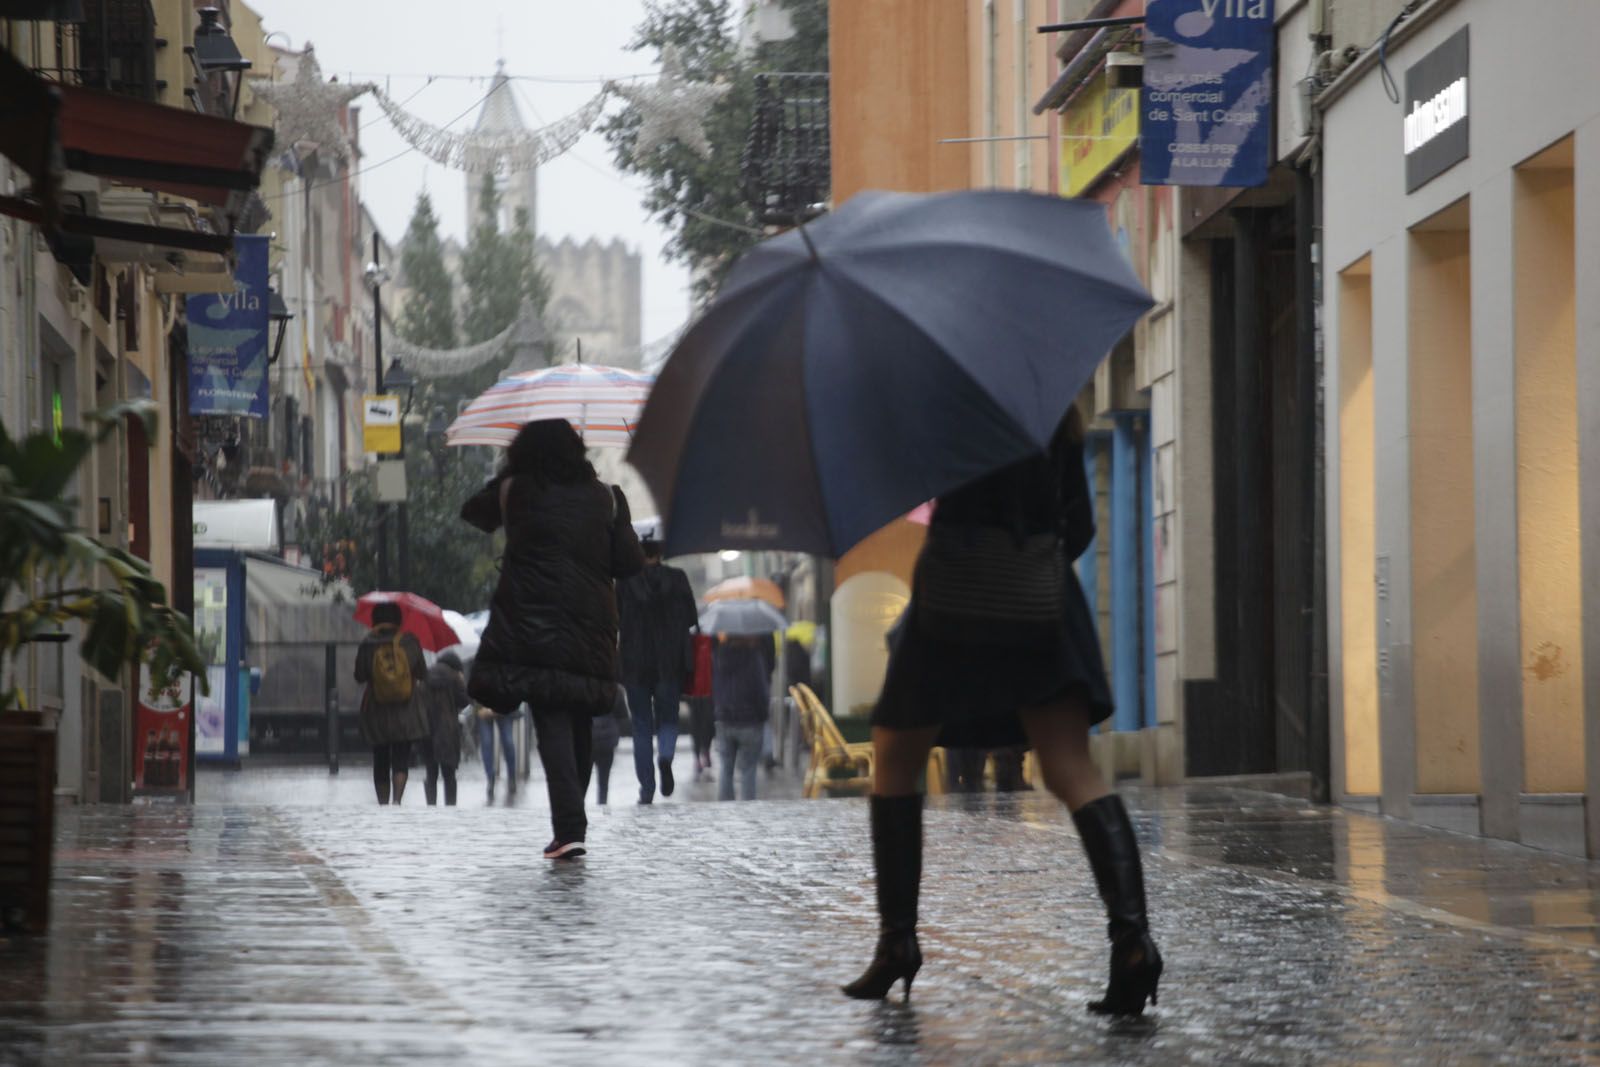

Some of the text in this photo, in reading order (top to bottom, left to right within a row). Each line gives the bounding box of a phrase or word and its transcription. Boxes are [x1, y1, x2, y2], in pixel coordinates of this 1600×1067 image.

[1149, 89, 1224, 103] comercial
[1148, 108, 1260, 125] de Sant Cugat
[1168, 143, 1238, 155] COSES PER
[1183, 158, 1200, 168] LA
[217, 289, 260, 311] Vila
